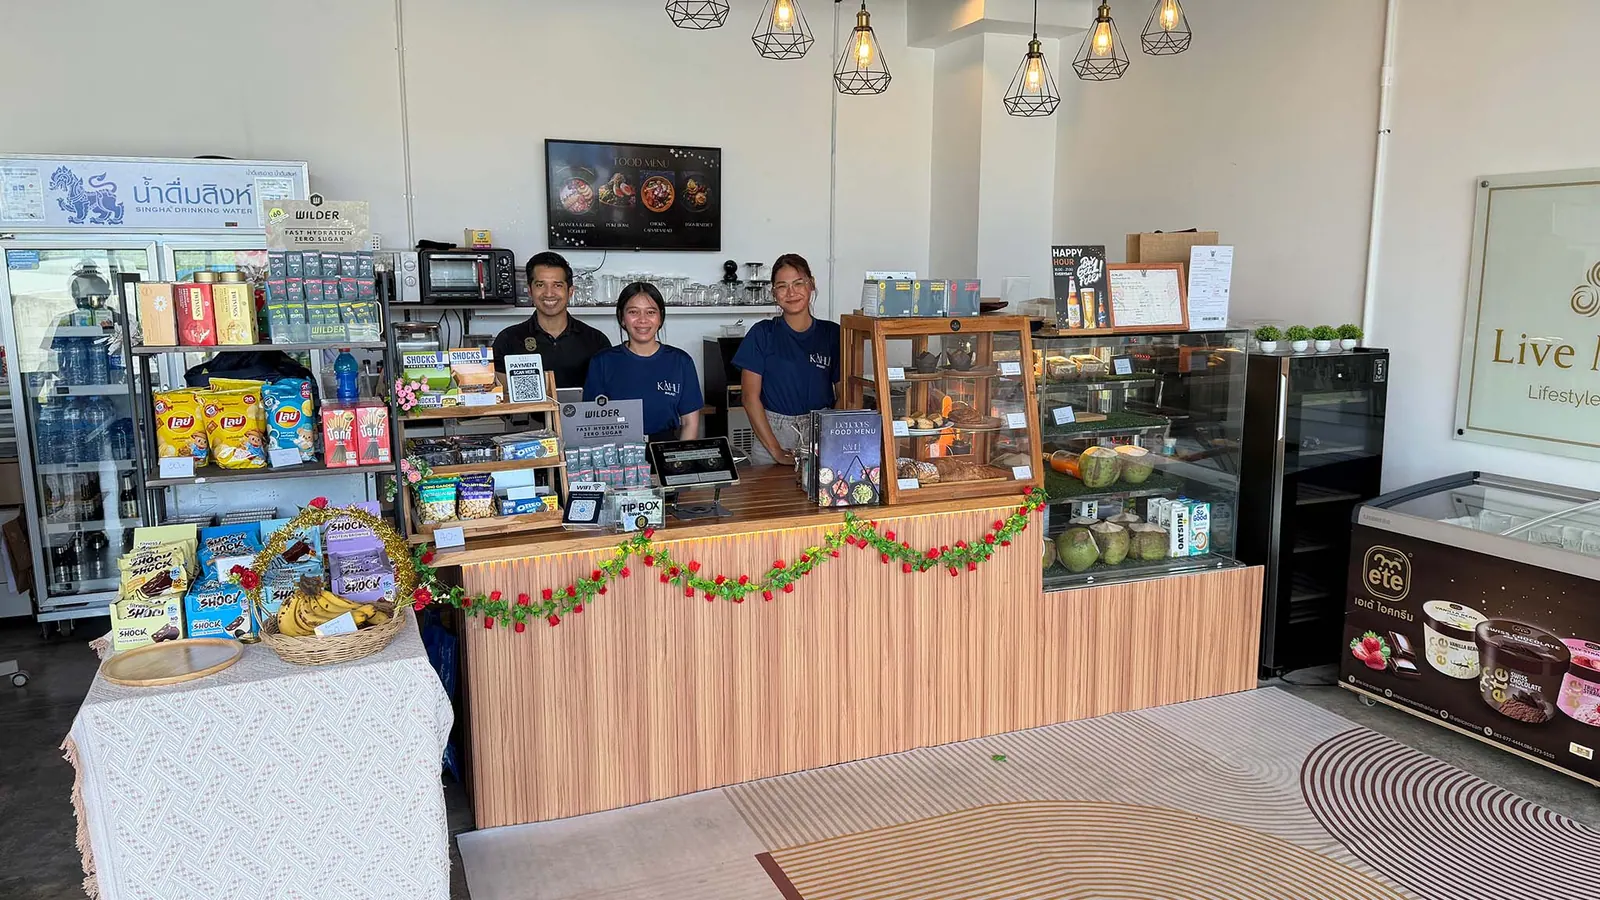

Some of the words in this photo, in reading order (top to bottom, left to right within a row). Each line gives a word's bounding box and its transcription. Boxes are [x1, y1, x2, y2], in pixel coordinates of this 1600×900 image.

[614, 157, 642, 166] FOOD
[645, 159, 670, 168] MENU
[133, 177, 253, 205] น้ำดื่มสิงห์
[295, 210, 340, 220] WILDER
[1052, 248, 1083, 257] HAPPY
[311, 325, 346, 334] WILDER
[1492, 328, 1576, 369] Live
[406, 355, 436, 364] SHOCKS
[452, 351, 481, 360] SHOCKS
[1528, 384, 1600, 409] Lifestyle
[584, 408, 620, 419] WILDER
[517, 502, 541, 511] OREO
[548, 503, 555, 511] 5
[621, 504, 636, 513] TIP
[638, 501, 660, 511] BOX
[331, 521, 366, 532] SHOCK
[131, 558, 173, 579] SHOCK
[345, 577, 381, 592] SHOCK
[1368, 567, 1404, 591] ete
[1376, 600, 1414, 622] ไอศกรีม
[193, 620, 221, 629] SHOCK
[119, 627, 147, 638] SHOCK
[1511, 632, 1561, 651] CHOCOLATE
[1510, 671, 1528, 682] SWISS
[1509, 677, 1542, 692] CHOCOLATE
